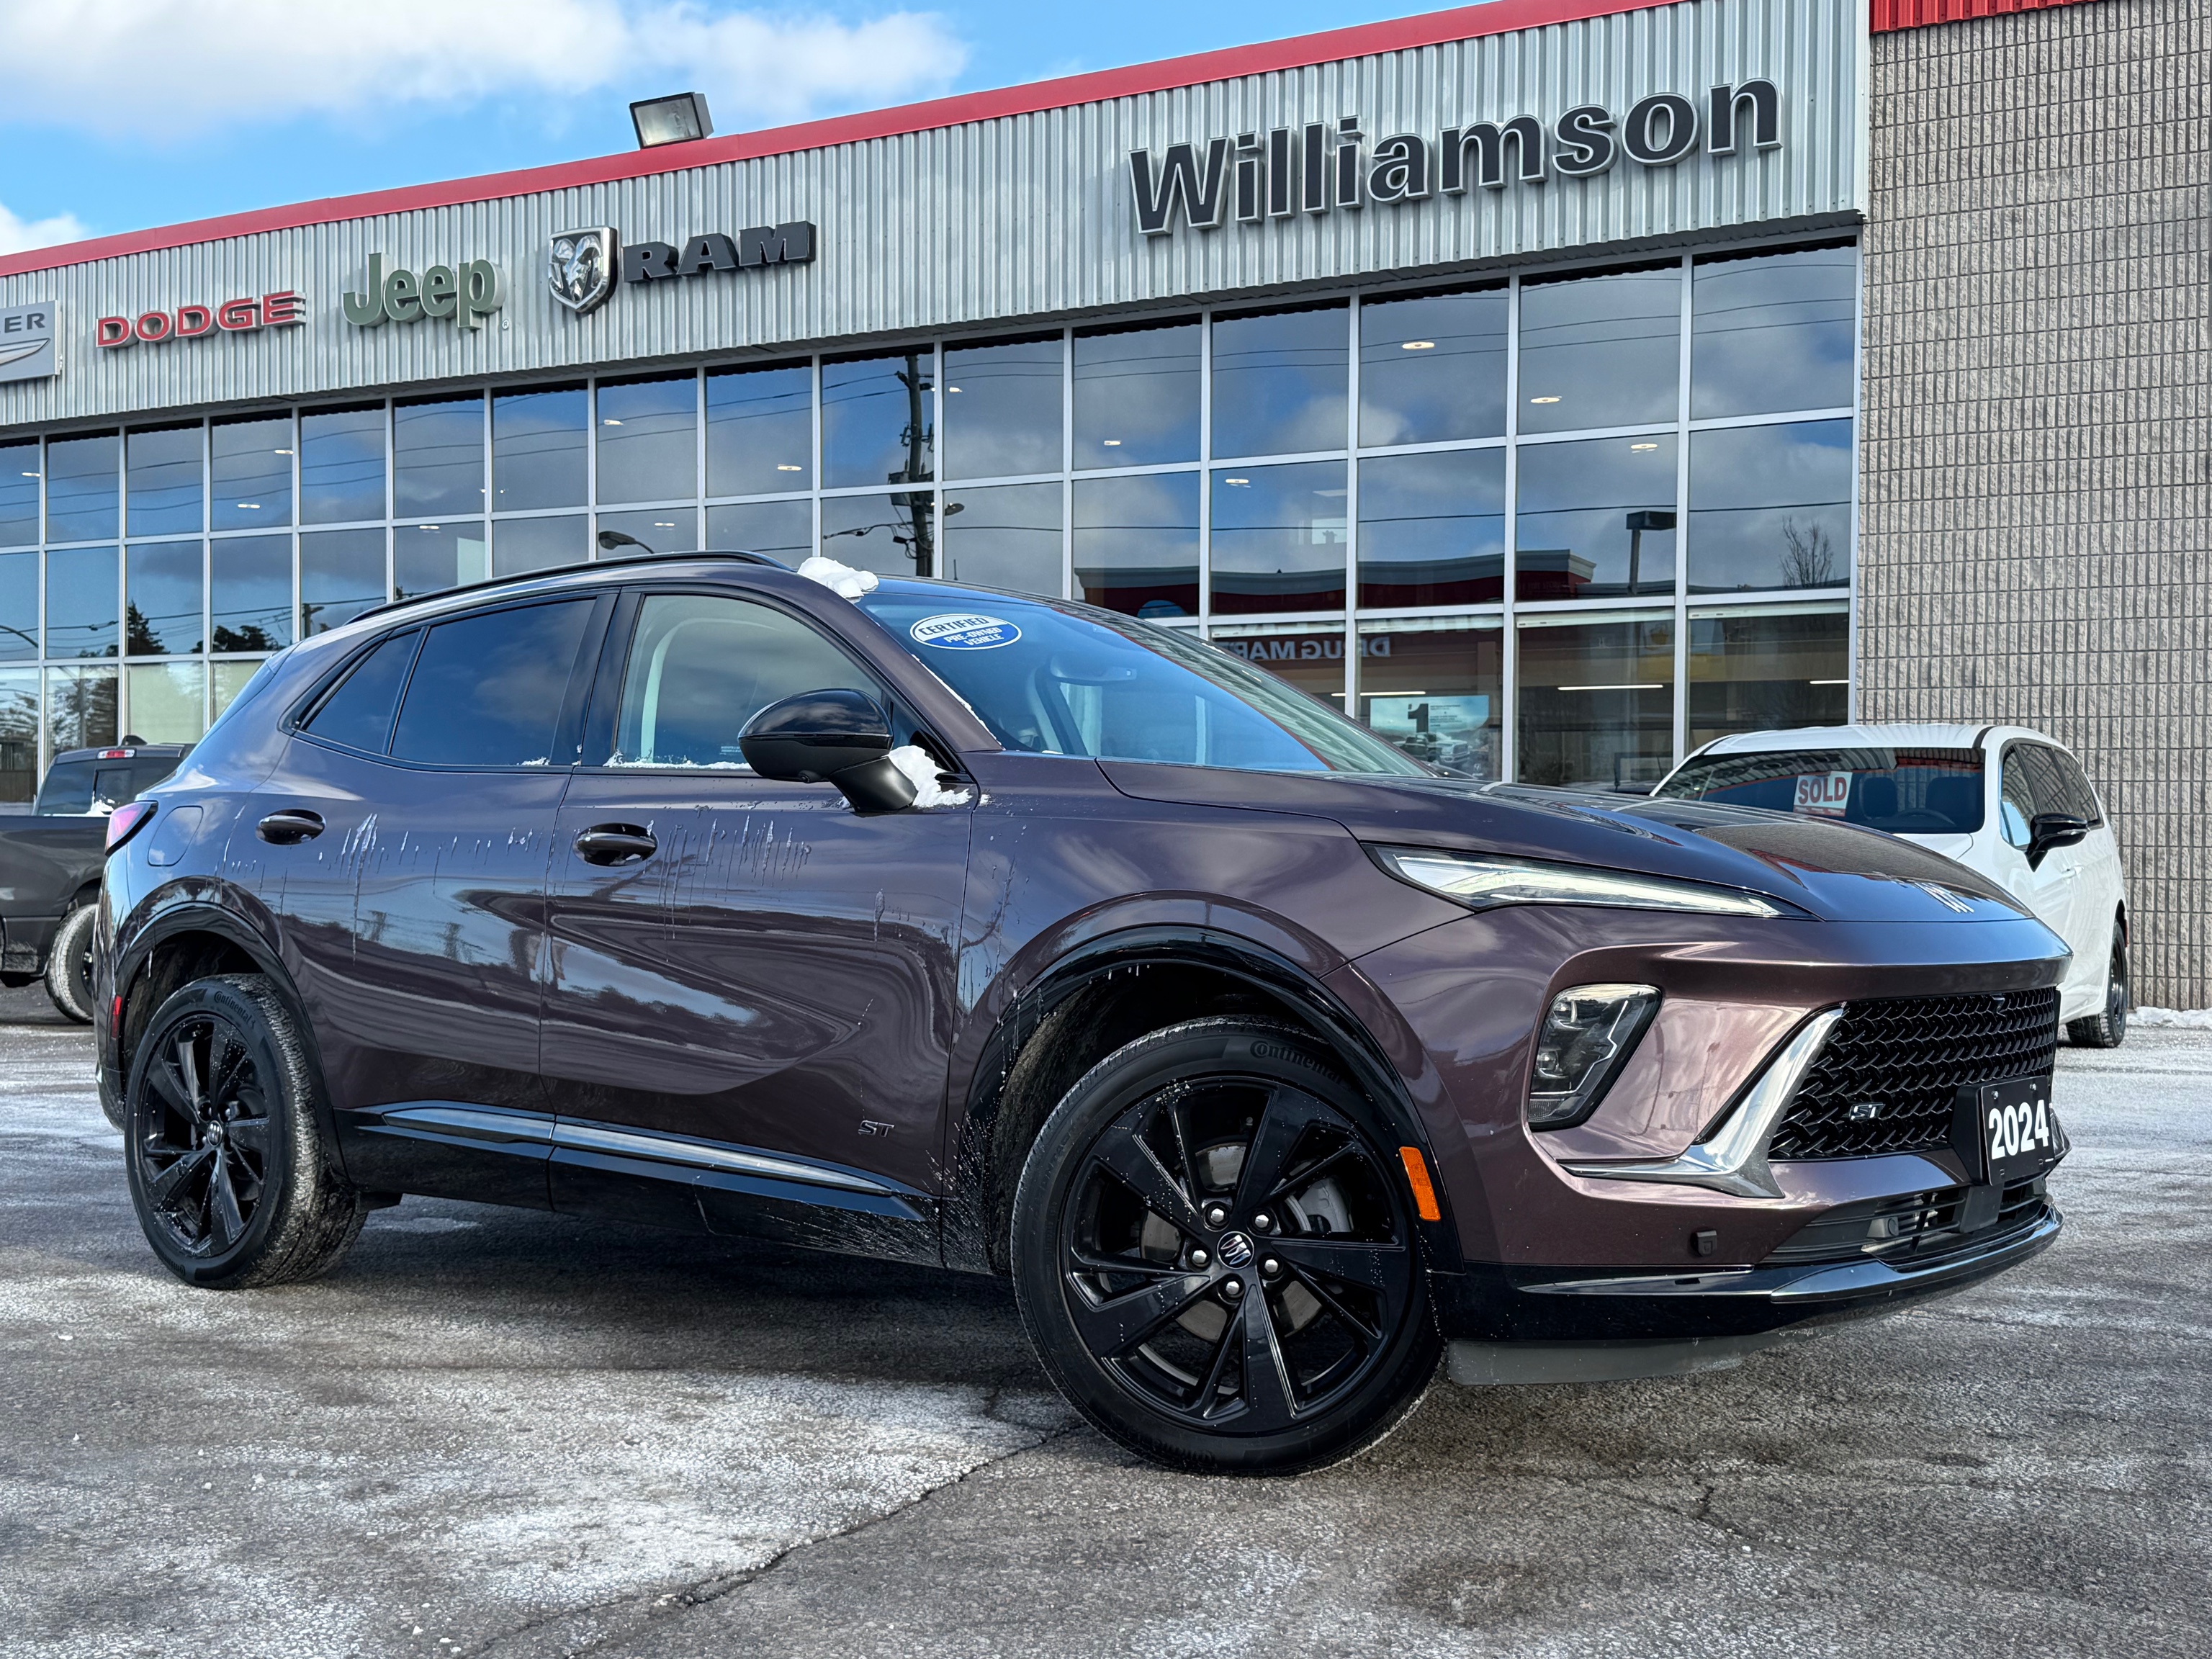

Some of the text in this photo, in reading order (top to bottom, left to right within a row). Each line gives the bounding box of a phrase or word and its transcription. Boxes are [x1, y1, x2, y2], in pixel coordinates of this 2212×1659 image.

[1128, 77, 1784, 235] Williamson
[621, 220, 817, 283] RAM
[343, 252, 504, 331] Jeep
[96, 289, 307, 349] DODGE
[918, 617, 990, 635] CERTIFIED
[943, 626, 1003, 643] PRE-OWNED
[963, 633, 1005, 646] VEHICLE
[1798, 777, 1847, 805] SOLD
[214, 990, 252, 1025] Continental
[1250, 1040, 1341, 1085] Continental
[858, 1120, 895, 1138] ST
[1849, 1102, 1886, 1121] ST
[1988, 1099, 2049, 1160] 2024
